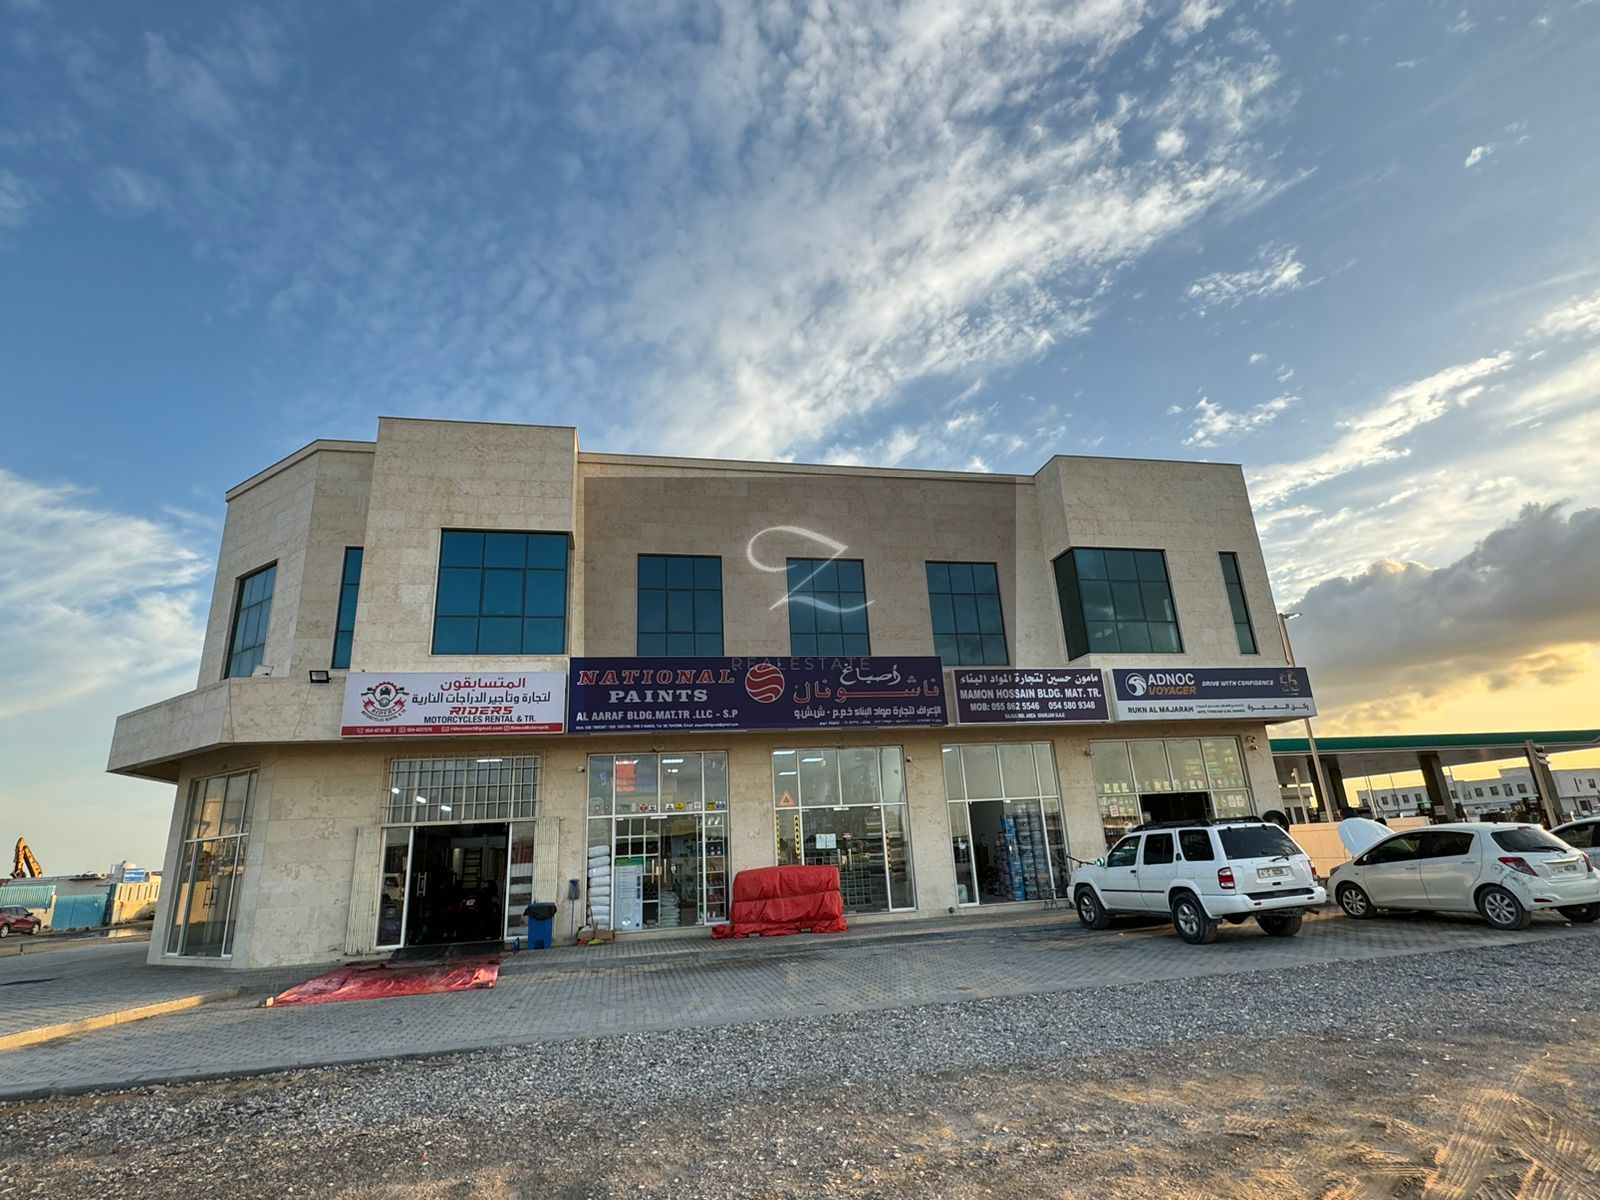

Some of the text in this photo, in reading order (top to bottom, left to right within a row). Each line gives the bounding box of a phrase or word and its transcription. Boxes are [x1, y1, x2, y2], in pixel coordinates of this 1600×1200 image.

[577, 669, 735, 686] NATIONAL
[840, 663, 901, 686] أصباغ
[960, 674, 987, 687] البناء
[1014, 673, 1044, 686] لتجارة
[1046, 674, 1072, 685] حسين
[1075, 673, 1099, 685] مامون
[1148, 673, 1195, 686] ADNOC
[440, 677, 526, 692] المتسابقون
[1149, 686, 1197, 695] VOYAGER
[412, 690, 551, 706] لتجارة وتأجير الدراجات النارية
[608, 689, 709, 703] PAINTS
[960, 687, 1102, 700] MAMON HOSSAIN BLDG. MAT. TR.
[450, 706, 514, 715] RIDERS
[873, 706, 892, 718] مواد
[970, 700, 1096, 711] MOB: 055 862 5546 054 580 9348
[1127, 706, 1148, 714] RUKN
[1159, 705, 1194, 713] MAJARAH
[424, 715, 484, 724] MOTORCYCLES
[485, 715, 514, 723] RENTAL
[524, 714, 537, 722] TR.
[576, 711, 589, 722] AL
[591, 711, 624, 721] AARAF
[722, 709, 739, 718] S.P
